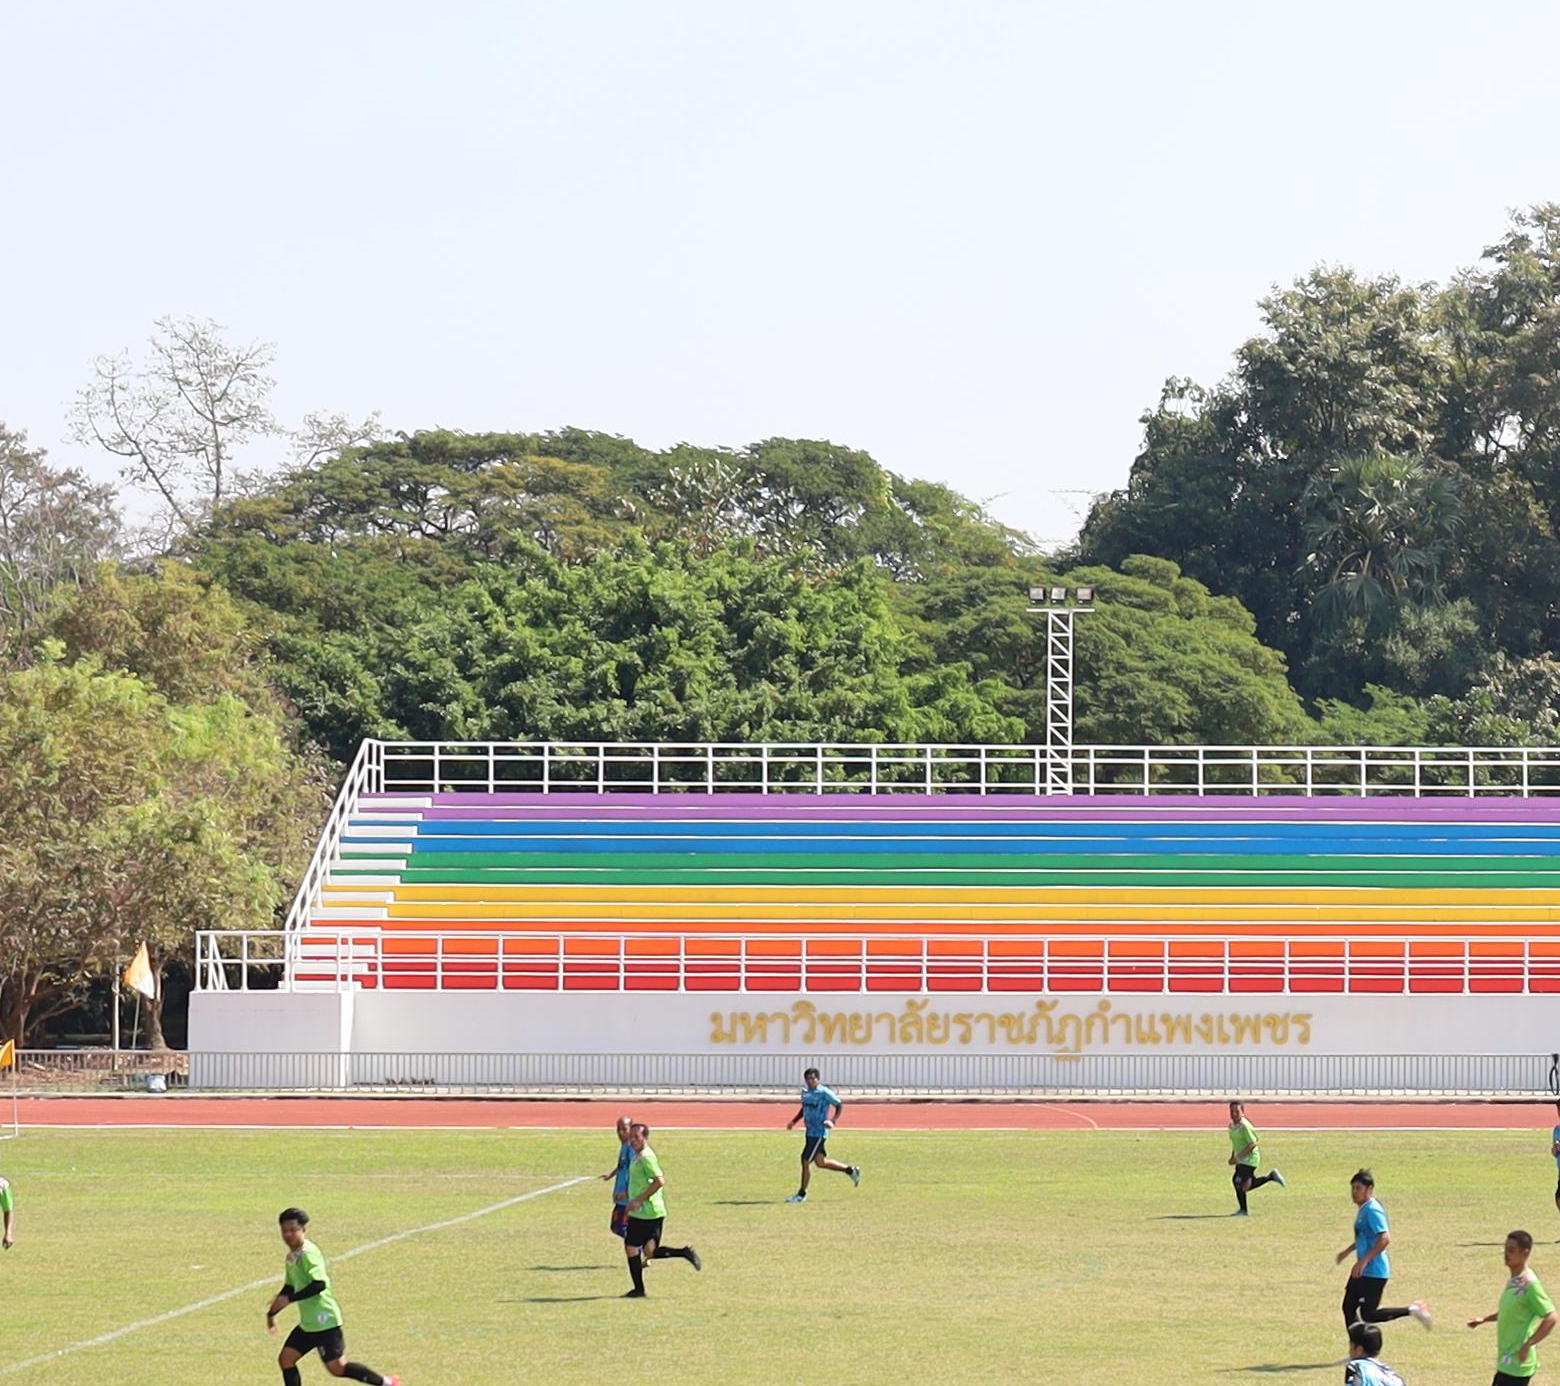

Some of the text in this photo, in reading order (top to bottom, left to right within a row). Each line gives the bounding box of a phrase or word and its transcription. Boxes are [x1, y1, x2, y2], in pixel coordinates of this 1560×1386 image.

[709, 998, 1313, 1063] มหาวิทยาลัยราชภัฏกำแพงเพชร
